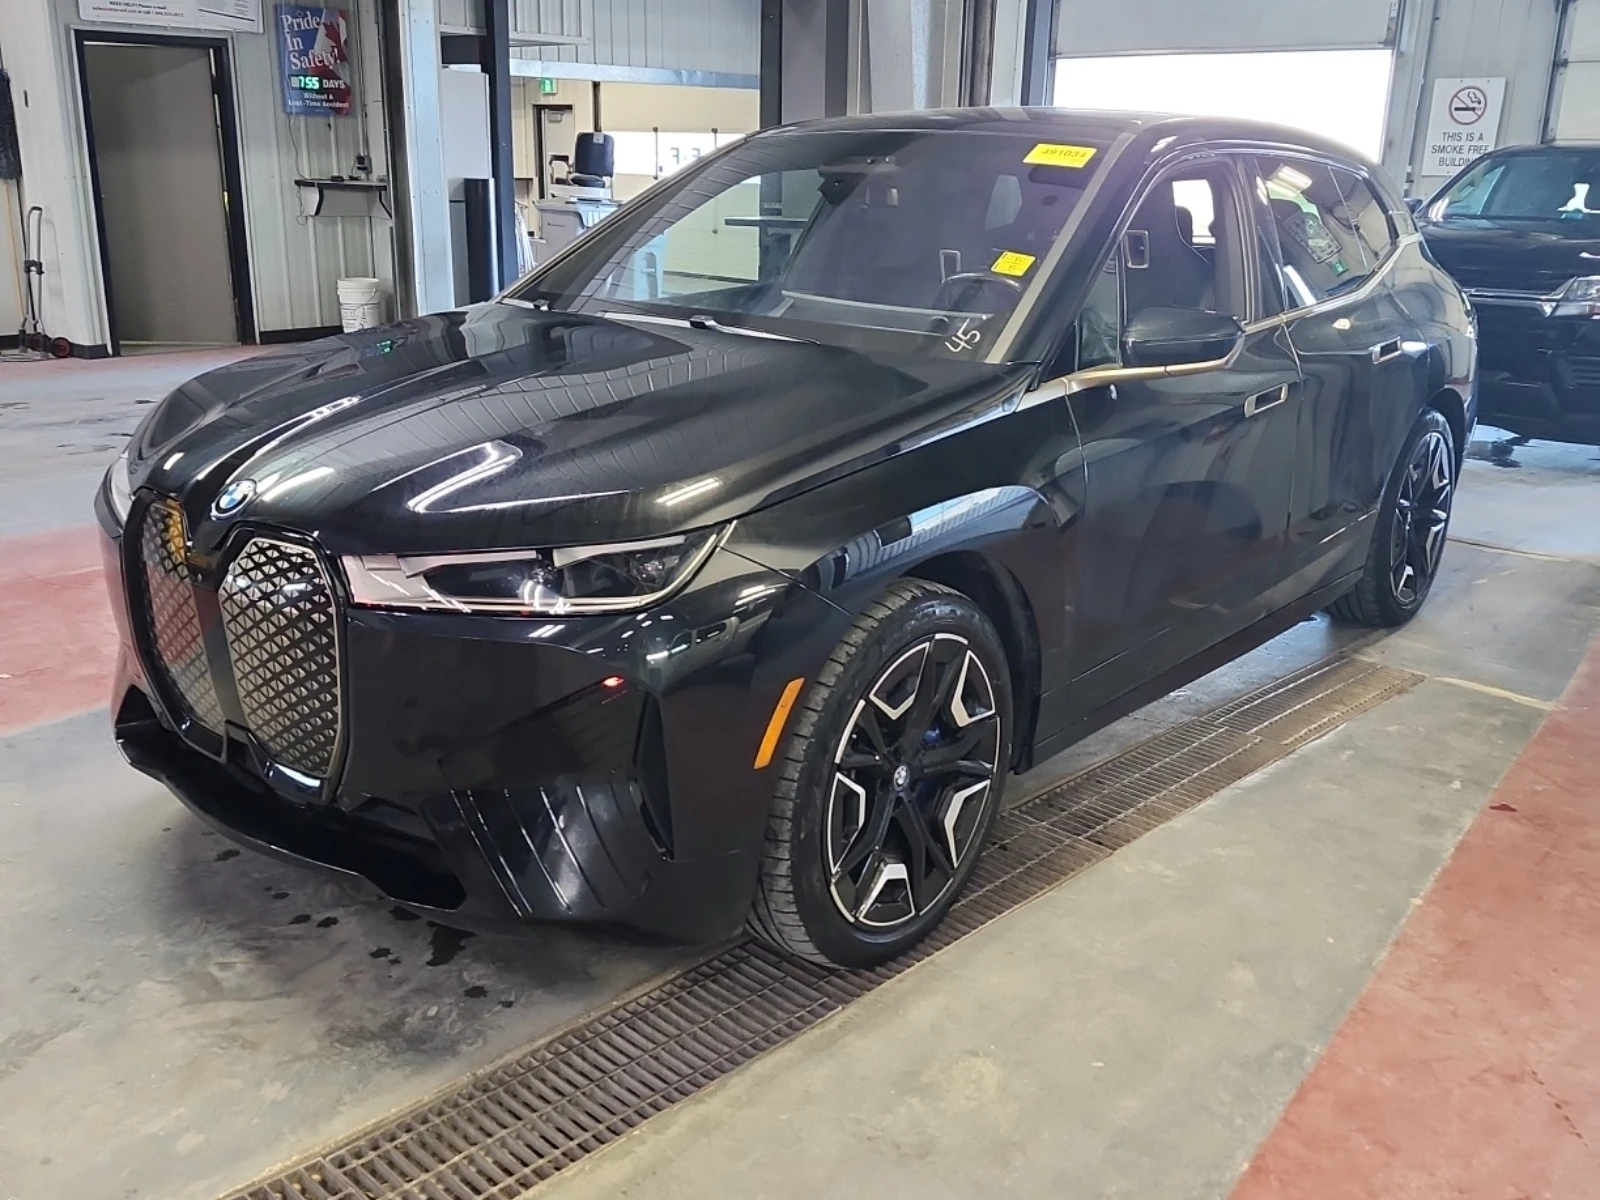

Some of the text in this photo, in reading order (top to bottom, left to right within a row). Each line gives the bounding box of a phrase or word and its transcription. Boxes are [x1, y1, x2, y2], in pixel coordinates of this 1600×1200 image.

[281, 11, 321, 32] Pride
[285, 33, 303, 50] In
[290, 48, 341, 69] Safety!
[322, 79, 346, 89] DAYS
[1442, 131, 1484, 142] THIS IS A
[1431, 144, 1466, 154] SMOKE
[944, 318, 980, 353] 45
